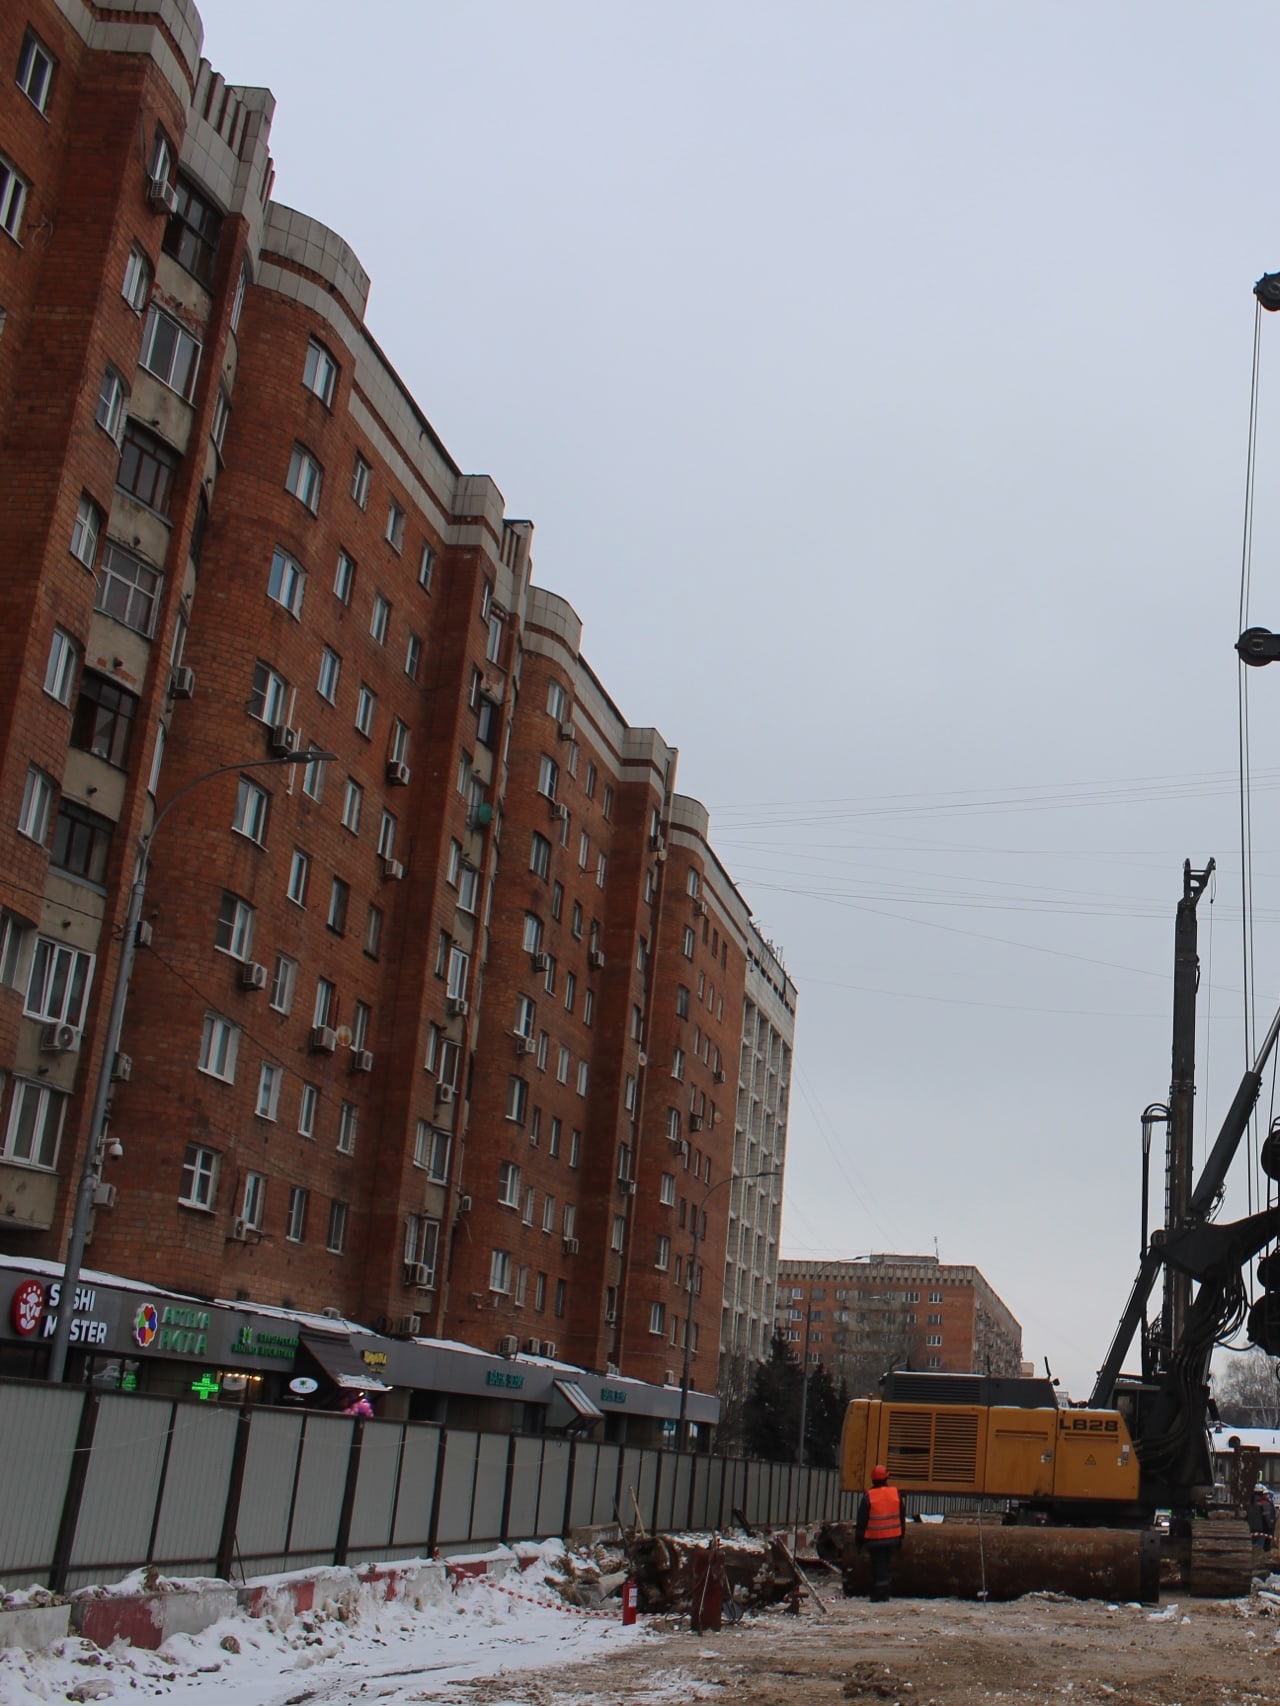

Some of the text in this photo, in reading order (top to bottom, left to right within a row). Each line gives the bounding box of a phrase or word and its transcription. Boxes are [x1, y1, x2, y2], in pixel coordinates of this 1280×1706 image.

[48, 1283, 96, 1312] SSHI
[43, 1315, 108, 1344] MSTER
[160, 1306, 212, 1329] АПТЕКА
[1059, 1418, 1118, 1432] LB28
